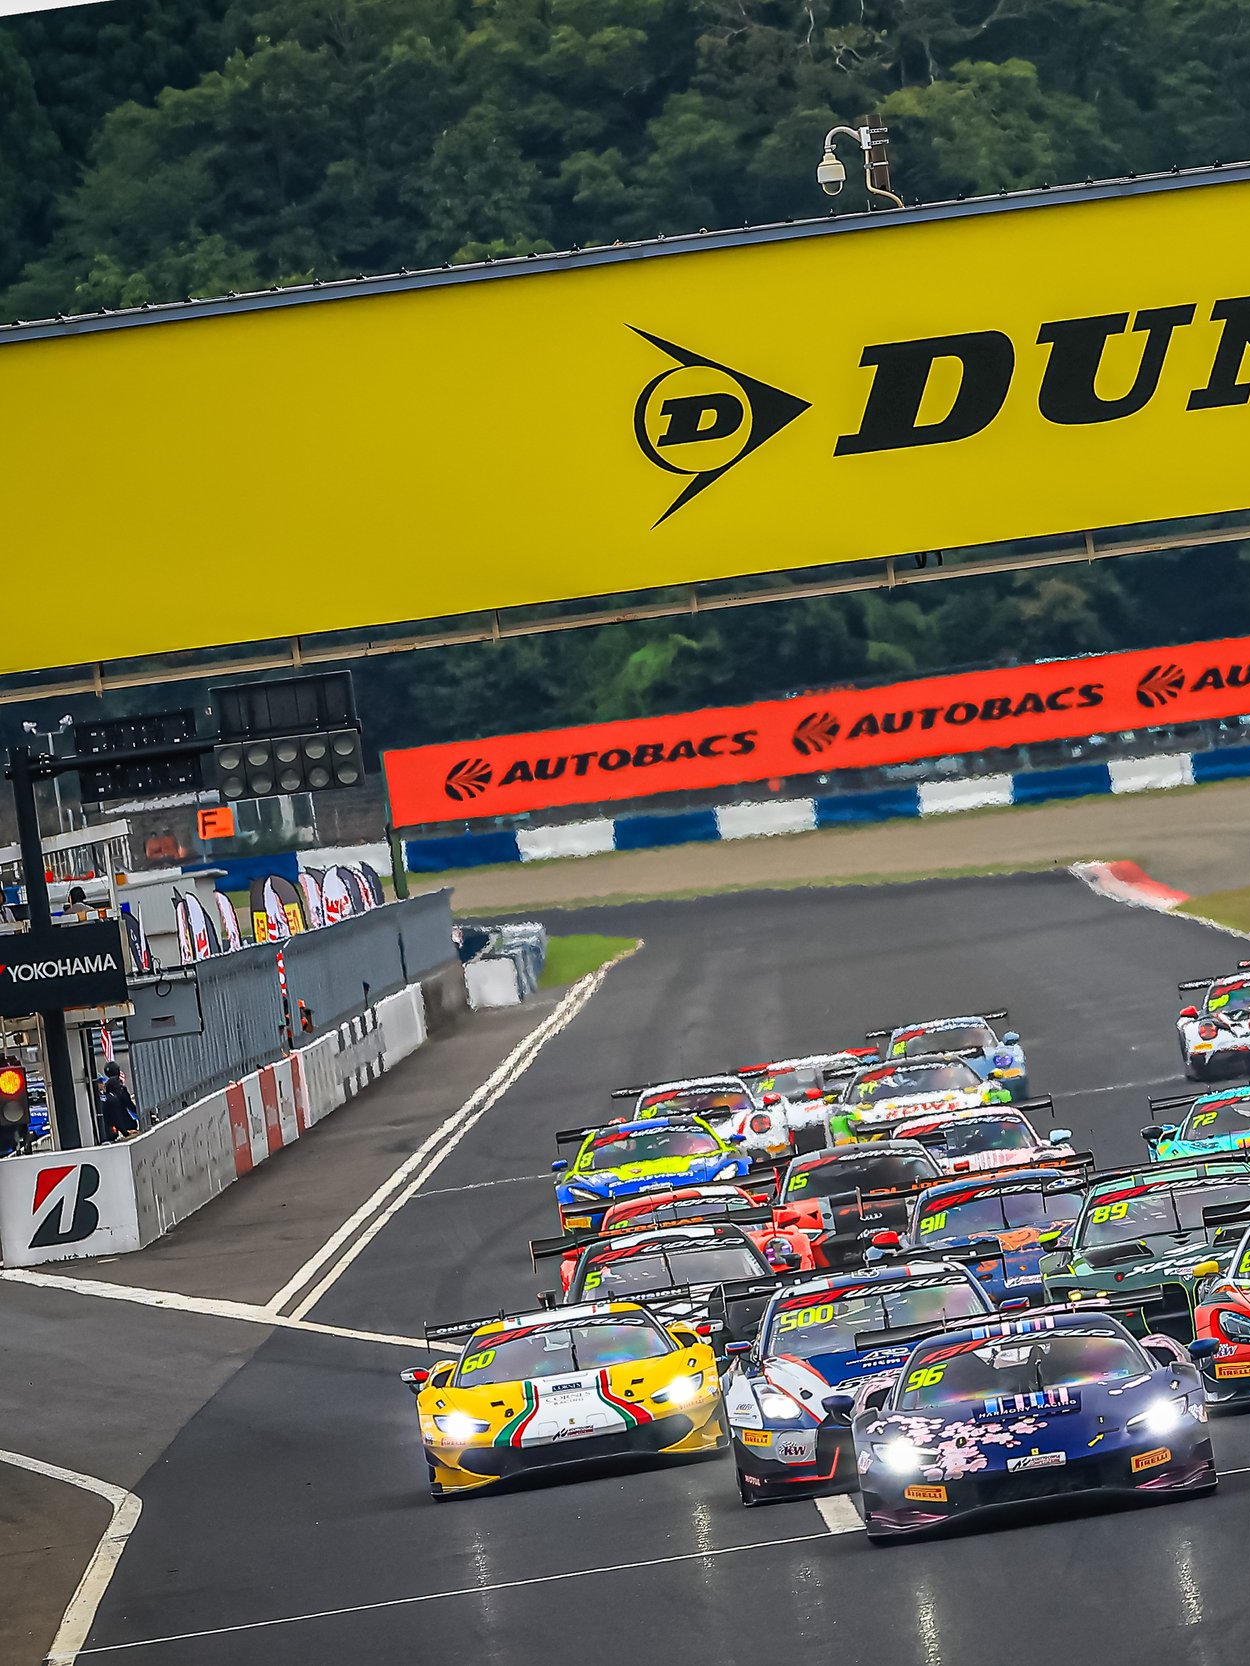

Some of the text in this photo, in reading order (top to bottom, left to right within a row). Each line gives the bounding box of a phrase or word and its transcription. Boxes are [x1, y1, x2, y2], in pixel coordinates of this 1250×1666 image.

[845, 684, 1104, 739] AUTOBACS
[497, 730, 758, 786] AUTOBACS
[201, 811, 218, 838] F
[7, 953, 118, 984] YOKOHAMA
[1192, 1111, 1219, 1129] 72
[788, 1172, 811, 1192] 15
[920, 1211, 947, 1236] 911
[1092, 1202, 1129, 1224] 89
[641, 1237, 746, 1254] WORLD
[584, 1271, 601, 1291] 5
[842, 1275, 968, 1298] WORLD
[533, 1316, 645, 1335] WORLD
[779, 1304, 834, 1334] 500
[983, 1327, 1117, 1347] WORLD
[461, 1350, 497, 1375] 60
[905, 1363, 948, 1393] 96
[979, 1399, 1077, 1419] HARMONY RACING
[745, 1433, 769, 1443] PIRELLI
[1135, 1449, 1168, 1469] PIRELLI
[907, 1488, 942, 1499] PIRELLI
